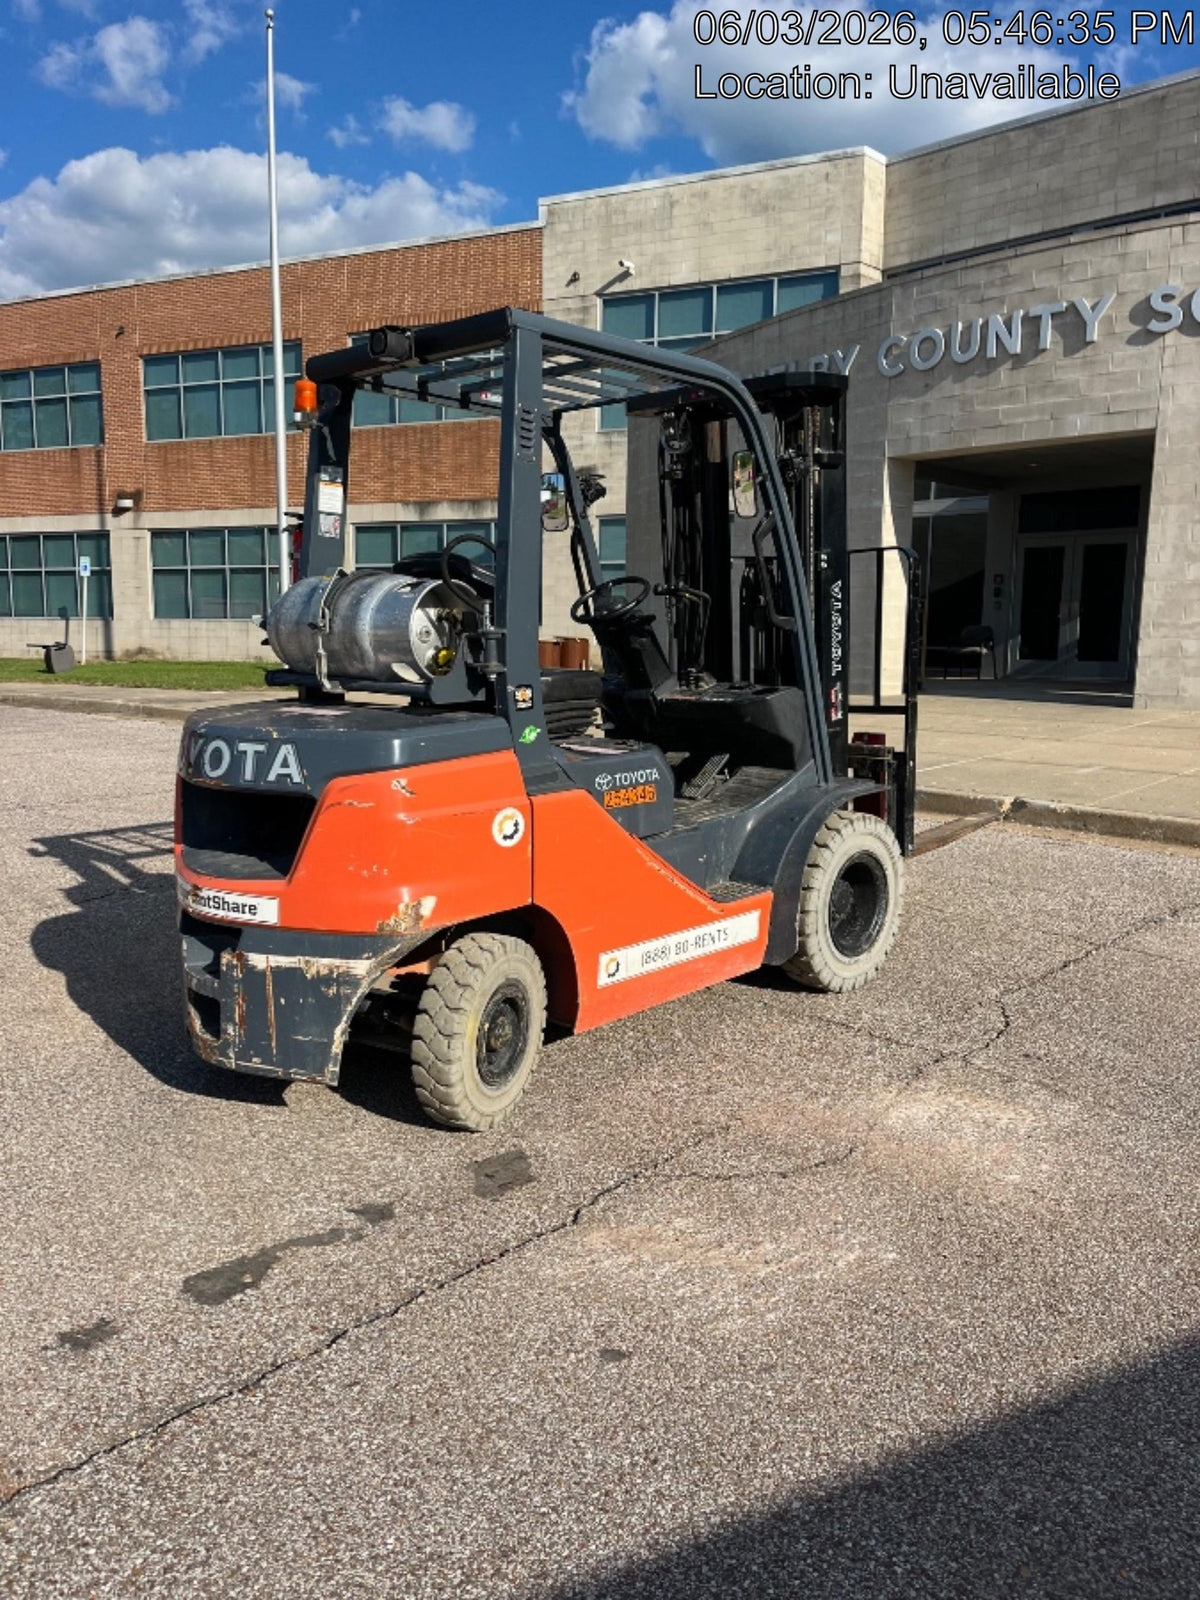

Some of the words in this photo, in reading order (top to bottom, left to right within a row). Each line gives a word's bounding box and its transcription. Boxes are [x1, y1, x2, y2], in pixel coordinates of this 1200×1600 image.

[877, 292, 1118, 377] COUNTY
[1146, 285, 1200, 333] S
[613, 767, 660, 787] TOYOTA
